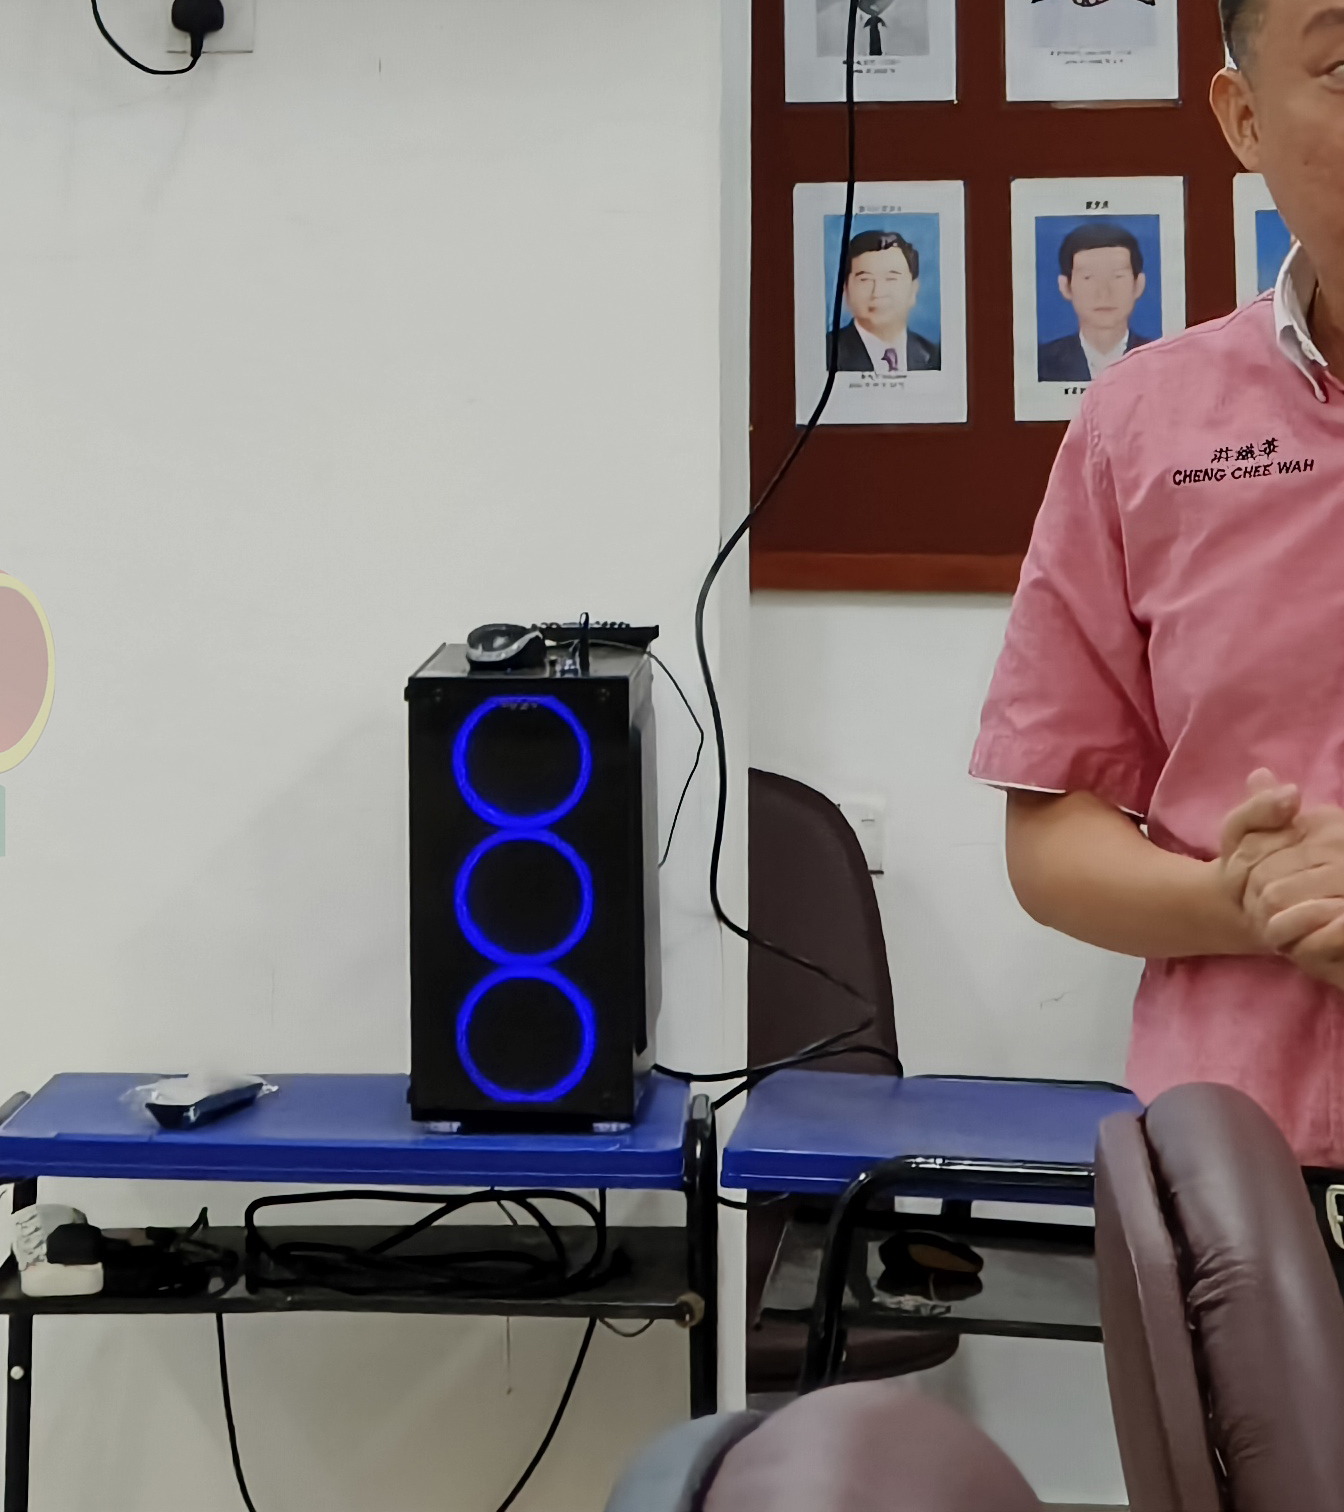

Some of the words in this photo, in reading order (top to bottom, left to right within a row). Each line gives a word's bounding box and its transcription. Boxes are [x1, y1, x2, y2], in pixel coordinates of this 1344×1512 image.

[1172, 468, 1227, 486] CHENG
[1230, 461, 1274, 480] CHEE
[1277, 458, 1315, 474] WAH
